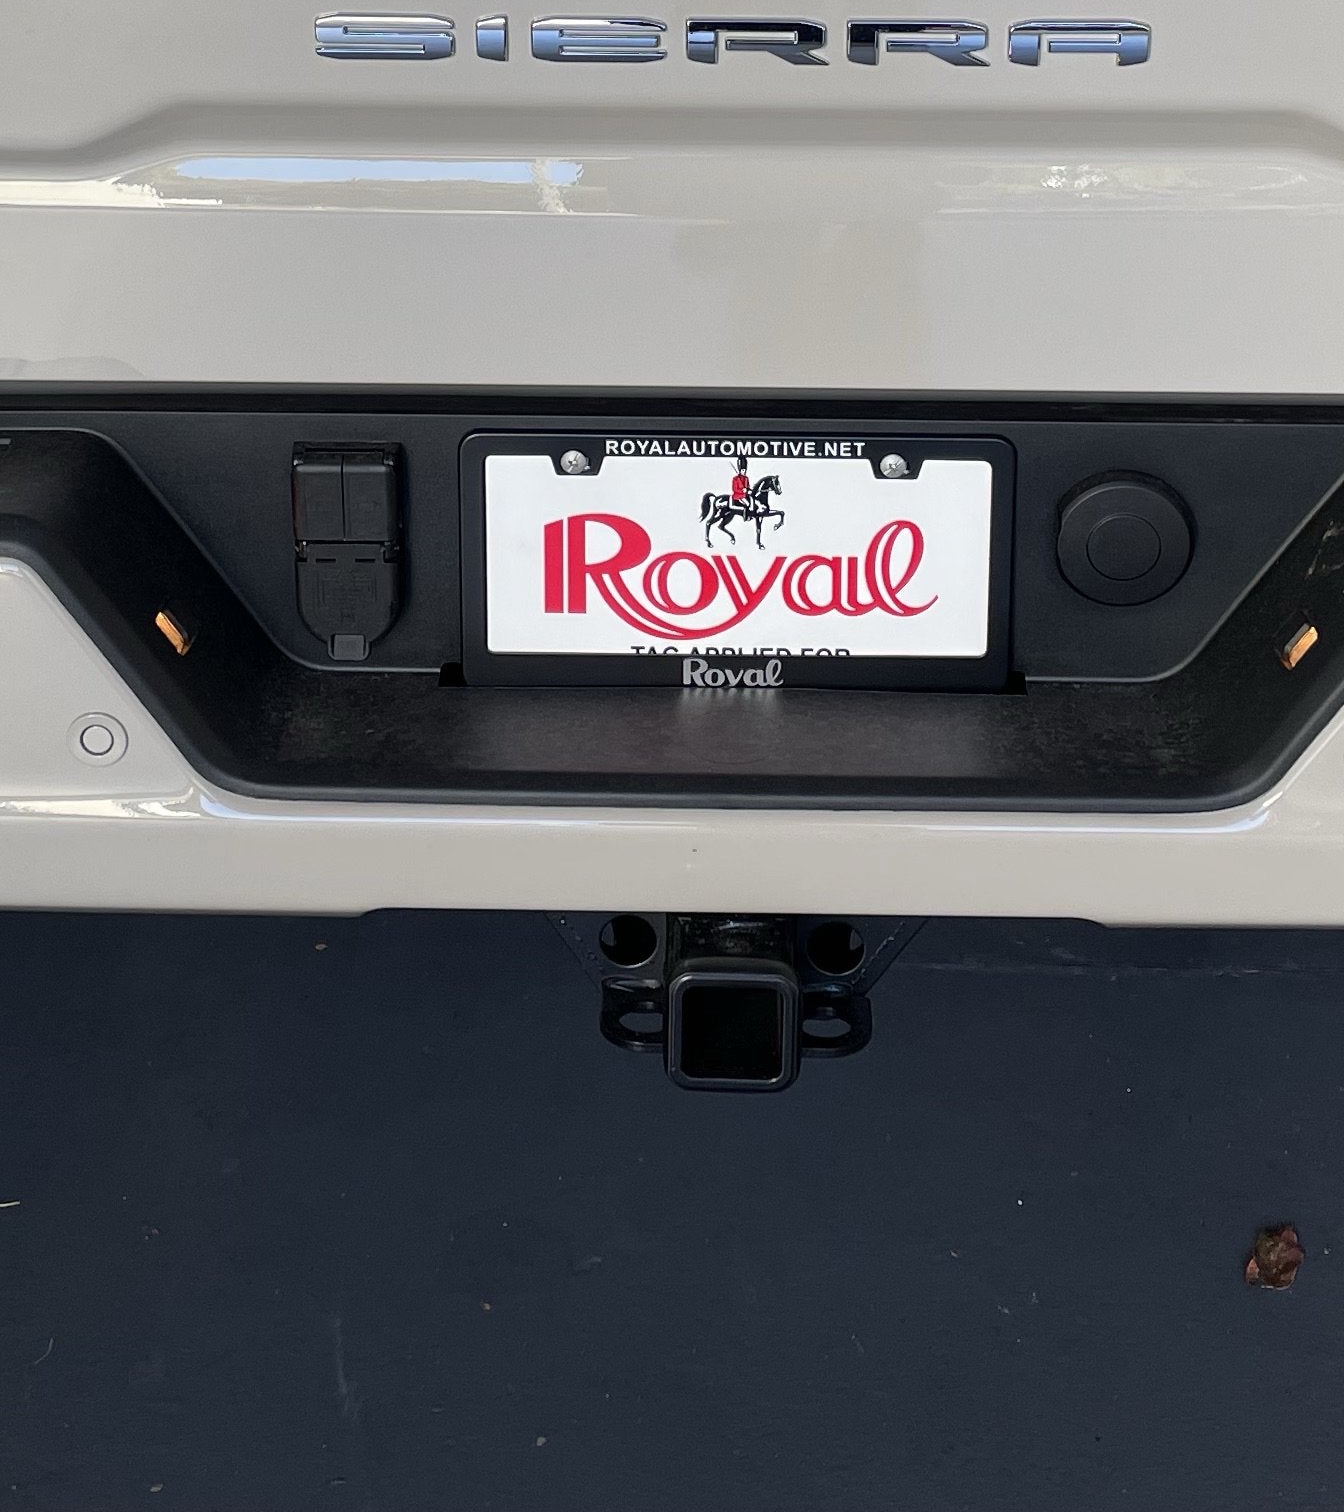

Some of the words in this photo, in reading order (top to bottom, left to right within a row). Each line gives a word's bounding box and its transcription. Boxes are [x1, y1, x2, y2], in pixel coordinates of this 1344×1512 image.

[314, 13, 1151, 66] SIERRA
[605, 439, 866, 457] ROYALAUTOMOTIVE.NET
[544, 513, 938, 640] Royal
[683, 658, 784, 687] Royal
